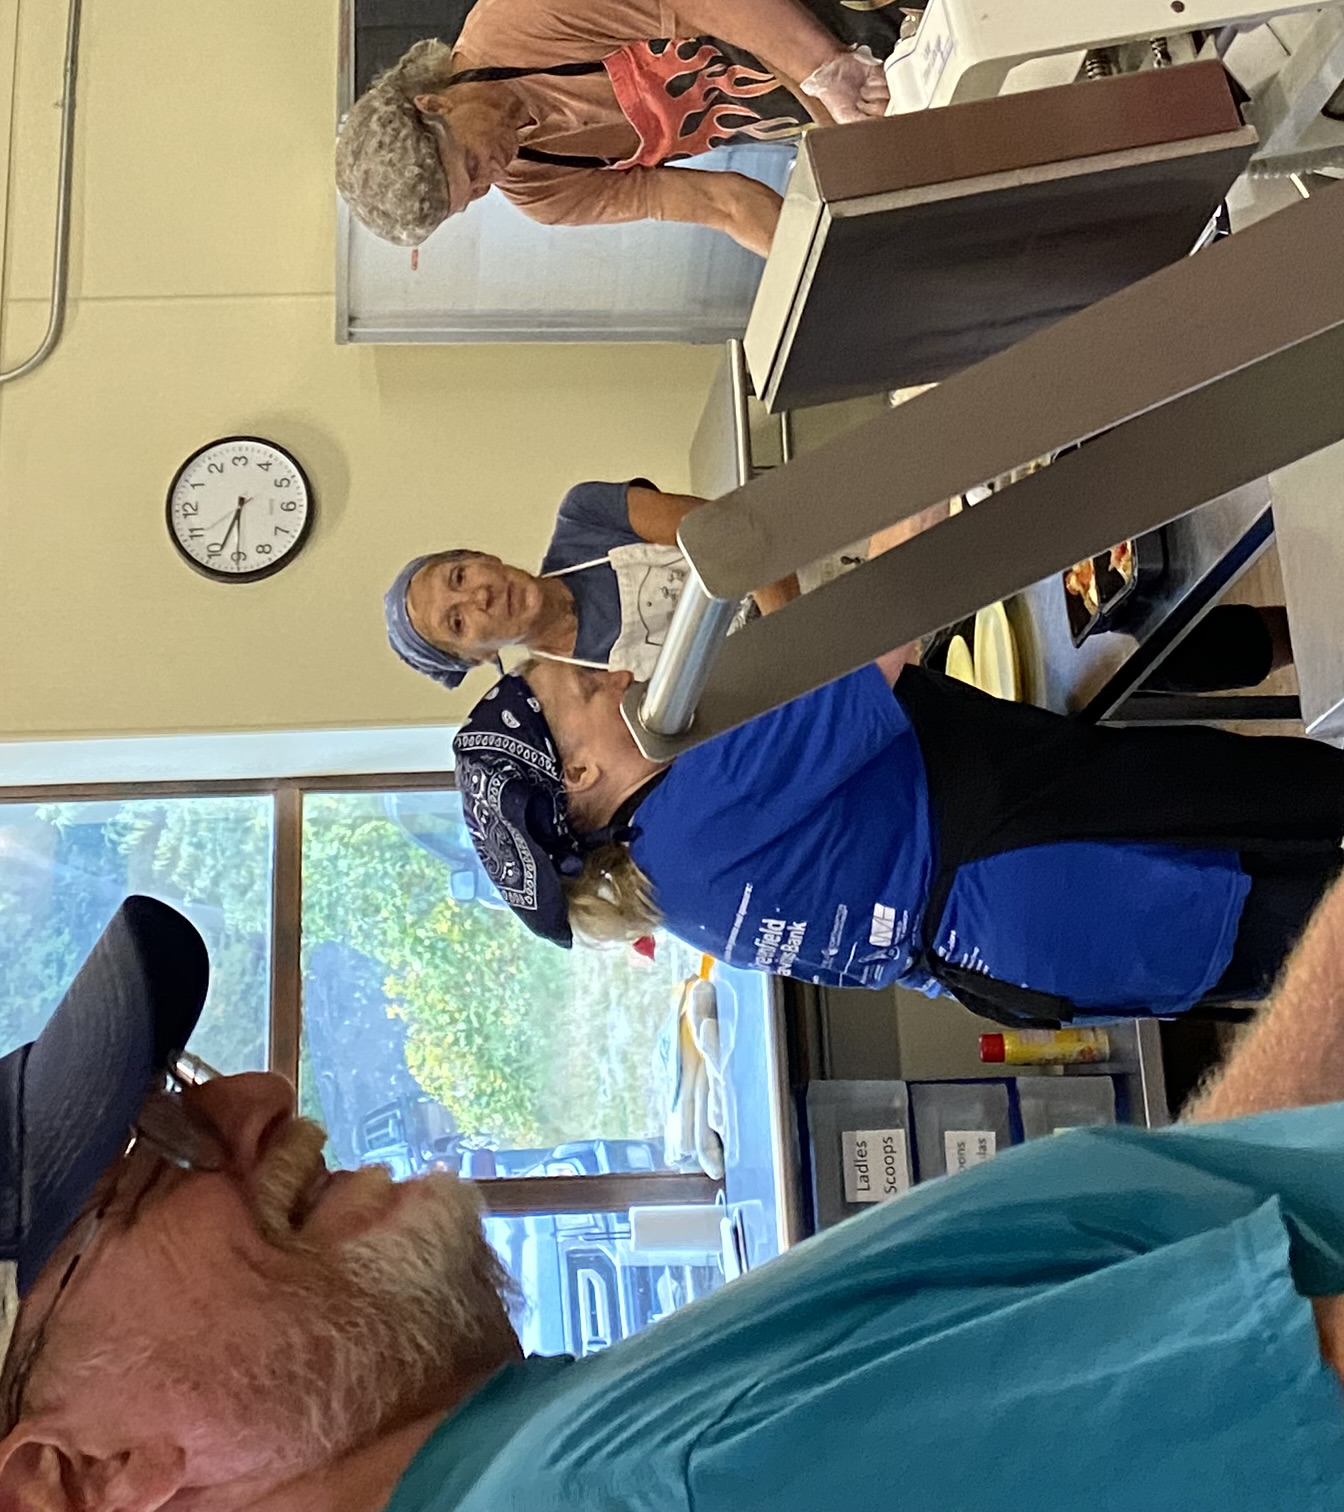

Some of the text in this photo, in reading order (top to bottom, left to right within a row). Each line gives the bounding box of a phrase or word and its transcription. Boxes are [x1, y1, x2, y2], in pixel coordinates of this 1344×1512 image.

[231, 456, 248, 467] 3
[257, 461, 272, 472] 4
[207, 463, 224, 473] 2
[274, 477, 290, 488] 5
[182, 502, 198, 519] 12
[280, 501, 296, 512] 6
[188, 527, 204, 540] 11
[274, 526, 290, 536] 7
[206, 543, 222, 559] 10
[256, 544, 272, 555] 8
[230, 551, 247, 562] 9
[780, 921, 807, 952] Bank
[853, 1140, 871, 1192] Ladles
[881, 1136, 898, 1194] Scoops
